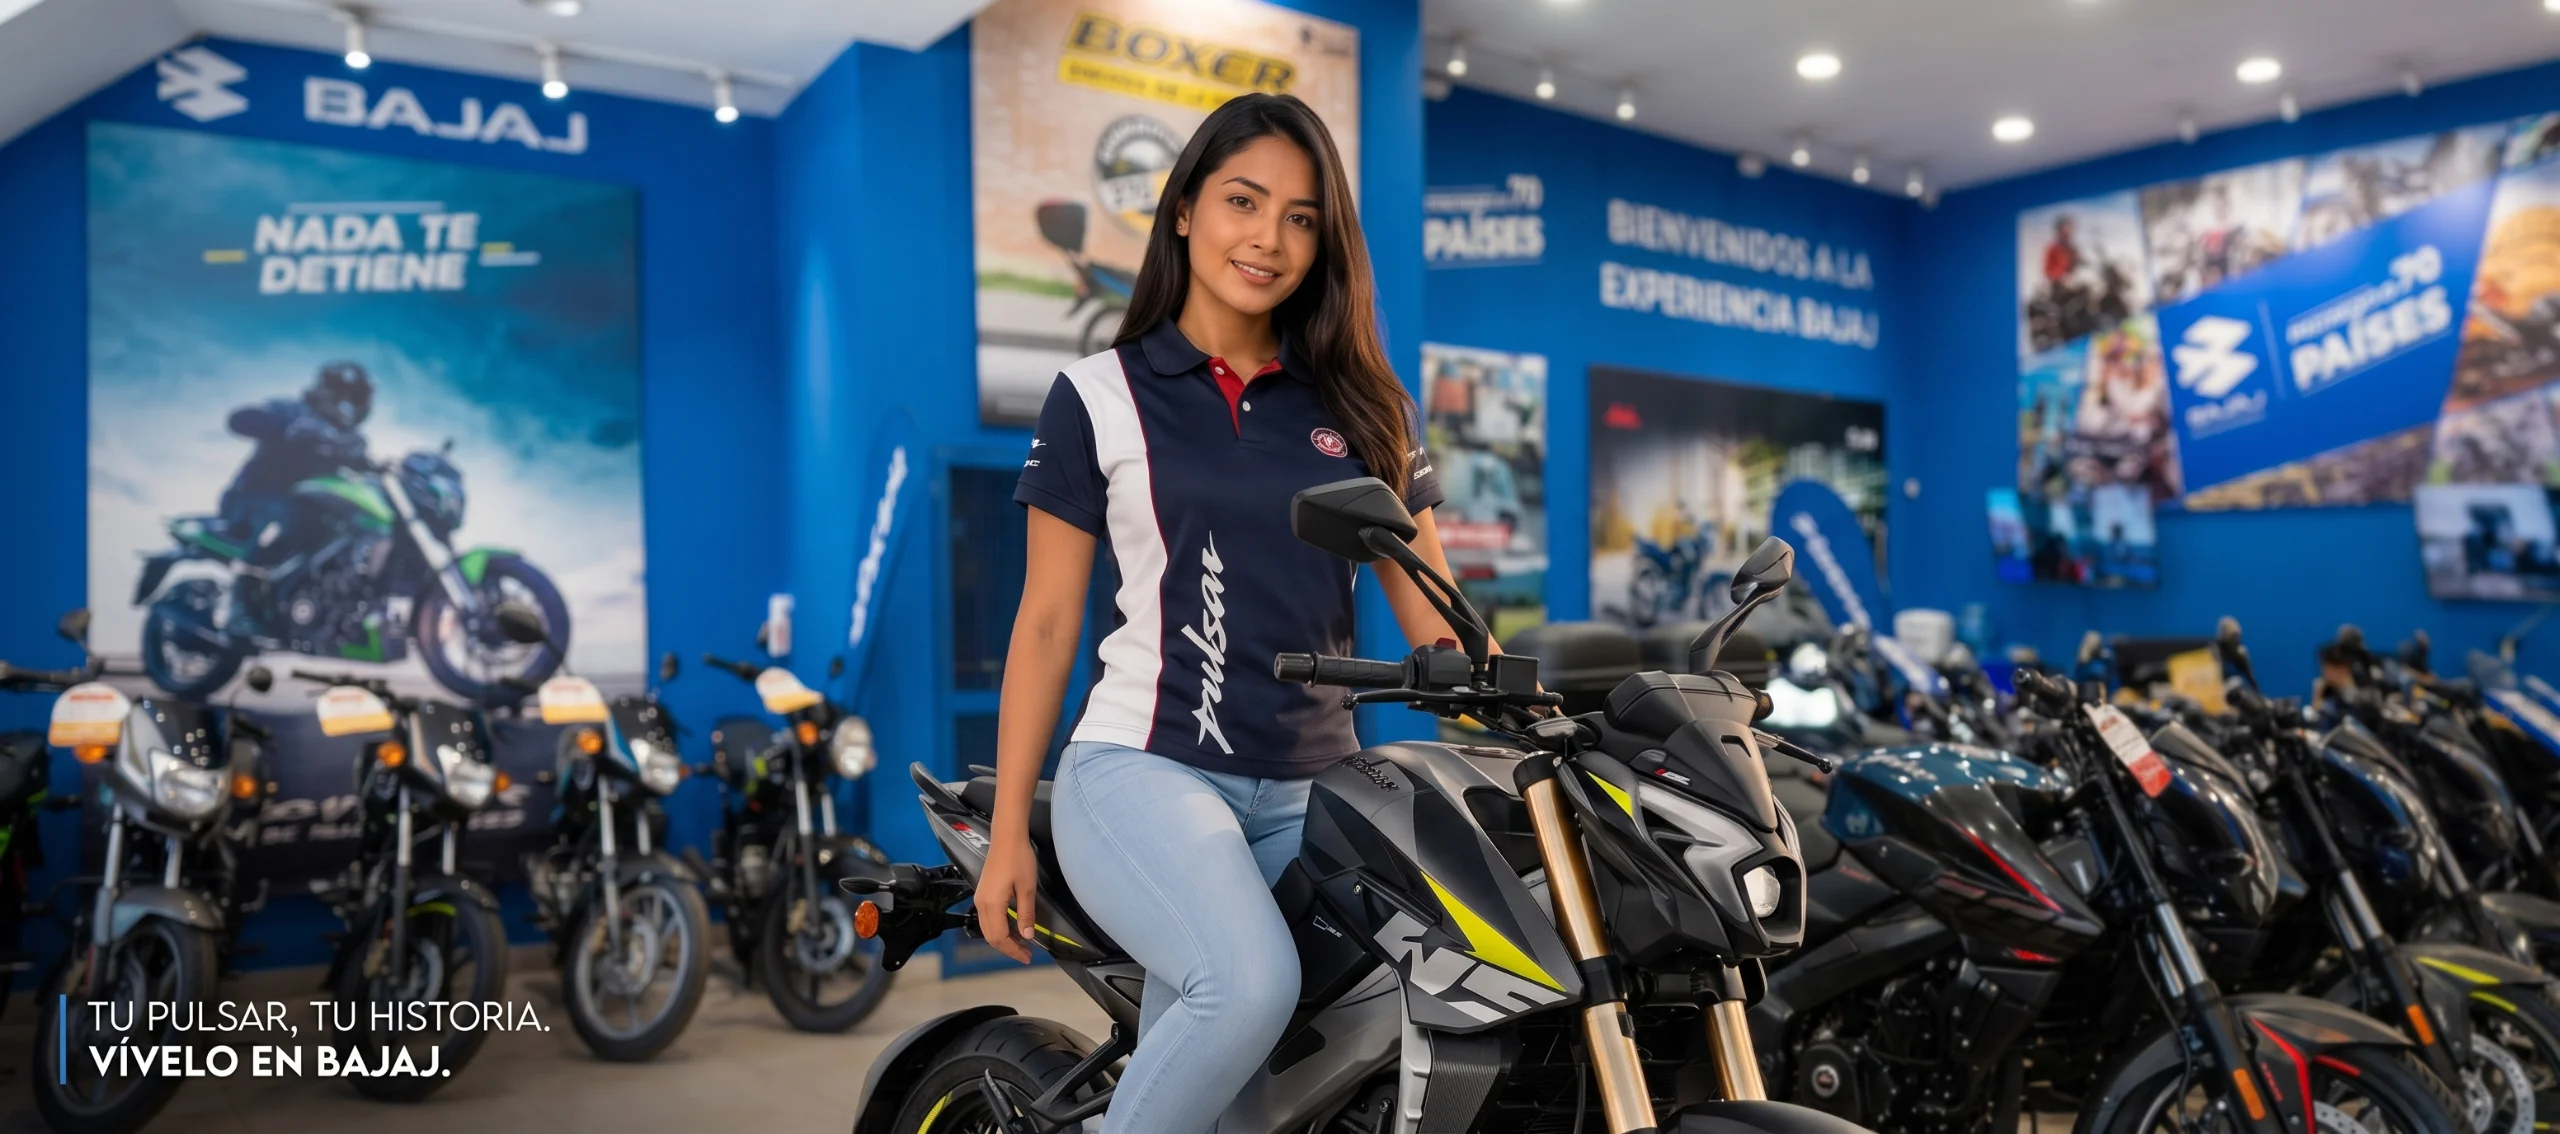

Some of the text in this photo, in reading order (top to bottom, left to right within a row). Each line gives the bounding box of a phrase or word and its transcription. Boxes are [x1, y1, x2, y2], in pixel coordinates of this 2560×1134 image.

[1073, 17, 1295, 91] BOXER
[304, 77, 589, 154] BAJAJ
[253, 212, 481, 252] NADA TE
[1811, 241, 1837, 285] A
[1835, 246, 1875, 292] LA
[258, 252, 468, 295] DETIENE
[1599, 259, 1799, 337] EXPERIENCIA
[2289, 284, 2452, 391] PAÍSES
[1181, 530, 1234, 754] pulsar
